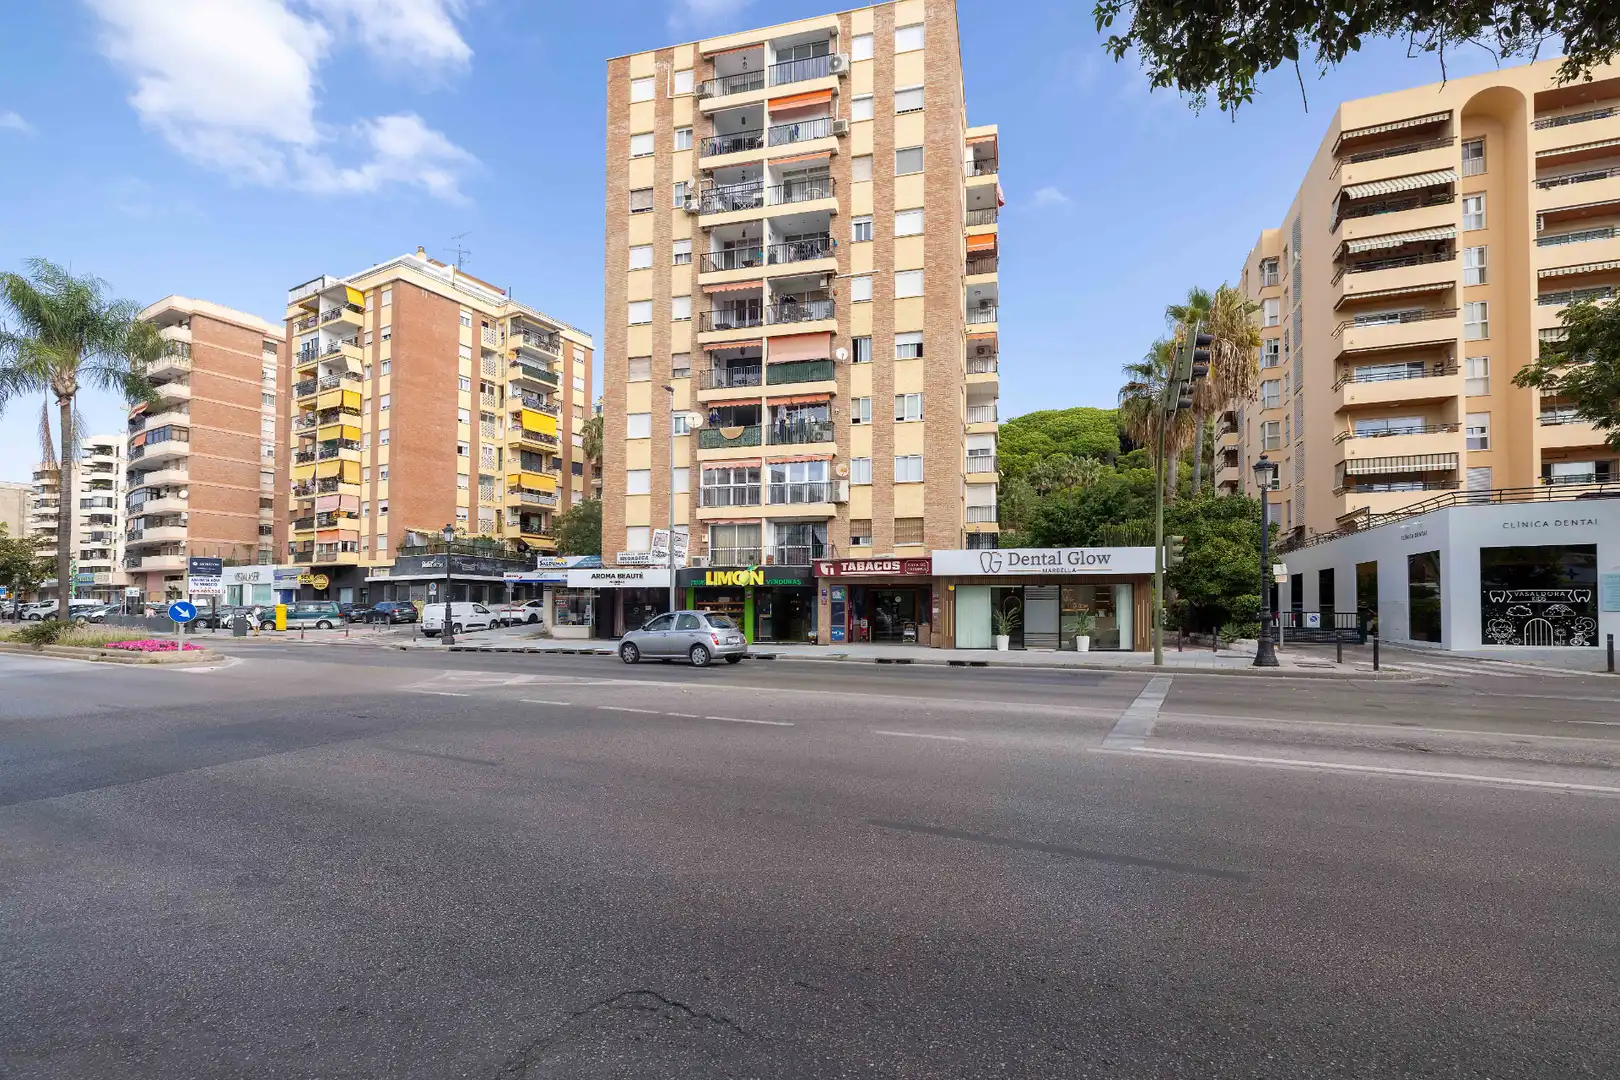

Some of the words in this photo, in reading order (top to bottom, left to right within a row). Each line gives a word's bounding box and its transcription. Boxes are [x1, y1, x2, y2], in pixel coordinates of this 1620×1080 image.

[1502, 520, 1549, 529] CLÍNICA
[1008, 551, 1062, 566] Dental
[1067, 551, 1111, 565] Glow
[841, 561, 900, 571] TABACOS
